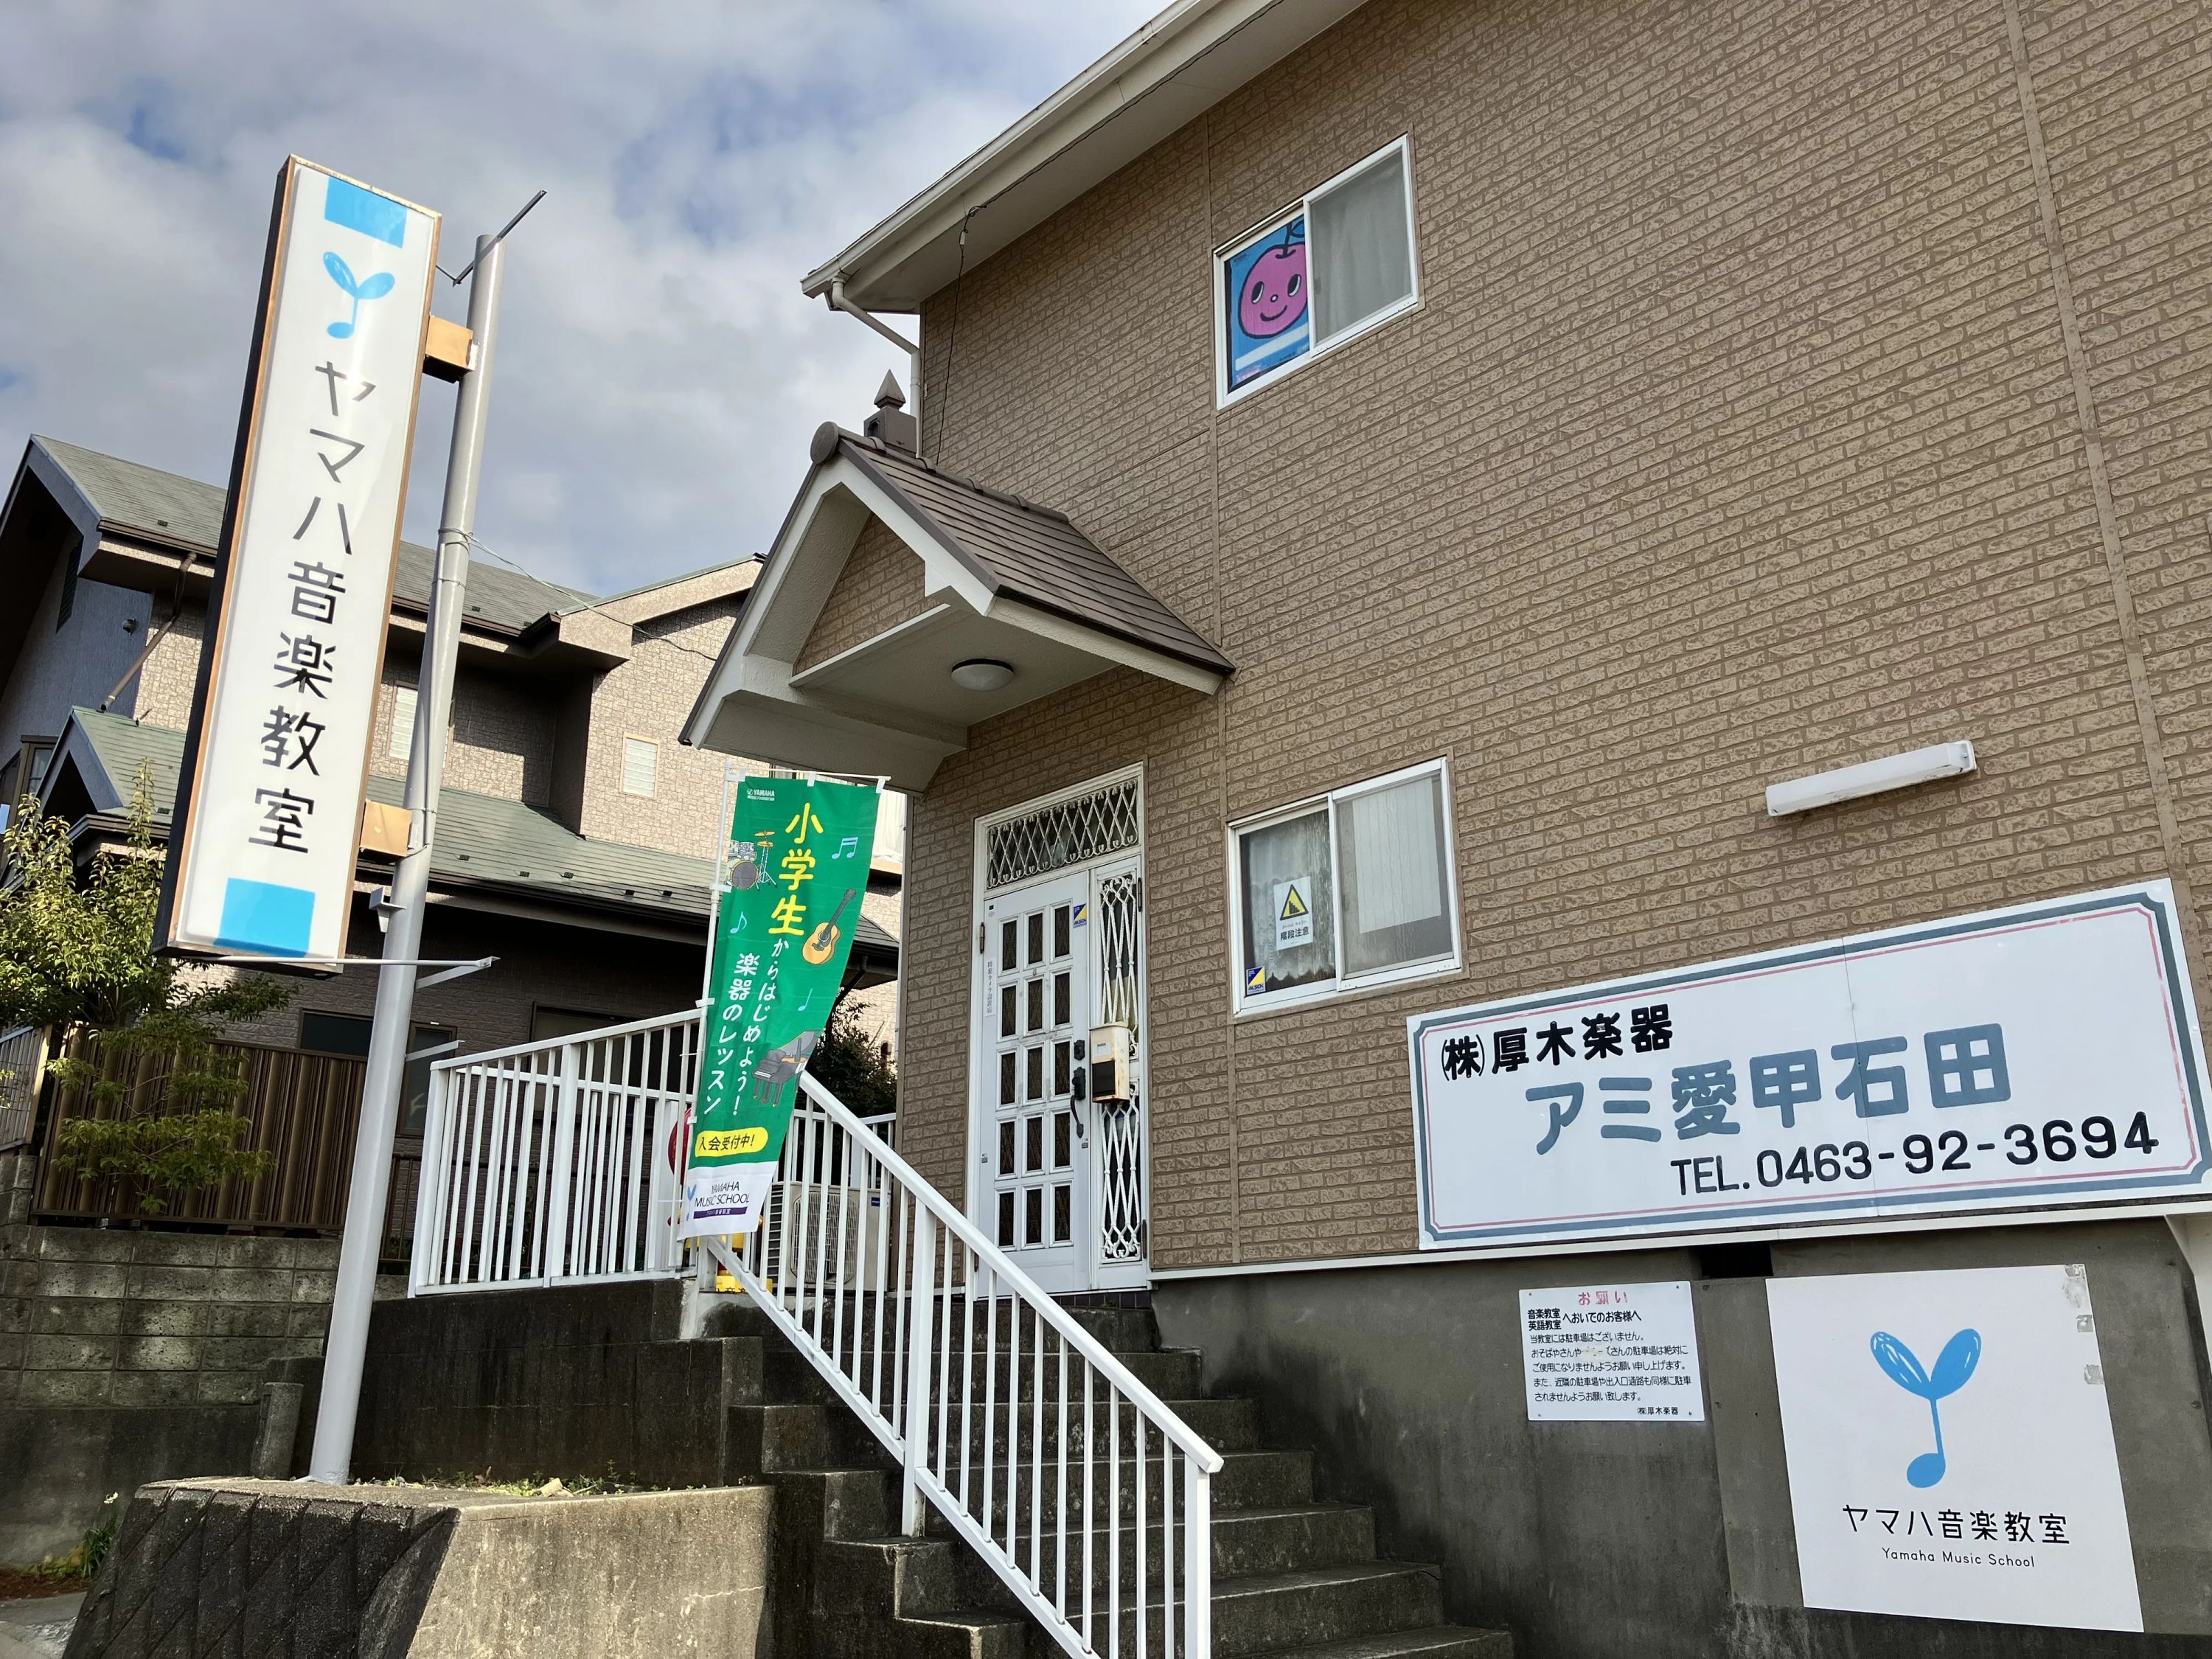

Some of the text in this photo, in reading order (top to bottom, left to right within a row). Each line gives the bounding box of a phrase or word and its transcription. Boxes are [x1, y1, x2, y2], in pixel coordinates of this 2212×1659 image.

[248, 361, 376, 853] ヤマハ音楽教室
[1280, 926, 1309, 941] 階段注意
[704, 953, 760, 1114] 楽器のレッスン
[1526, 1023, 2011, 1155] アミ愛甲石田
[699, 1133, 755, 1152] 入会受付中!
[711, 1181, 740, 1194] YAMAHA
[716, 1193, 750, 1205] SCHOOL
[1578, 1290, 1627, 1305] お願い
[1528, 1307, 1561, 1320] 音楽教室
[1528, 1319, 1562, 1331] 英語教室
[1843, 1504, 2070, 1544] ヤマハ音楽教室
[1882, 1547, 2034, 1568] Yamaha Music School
